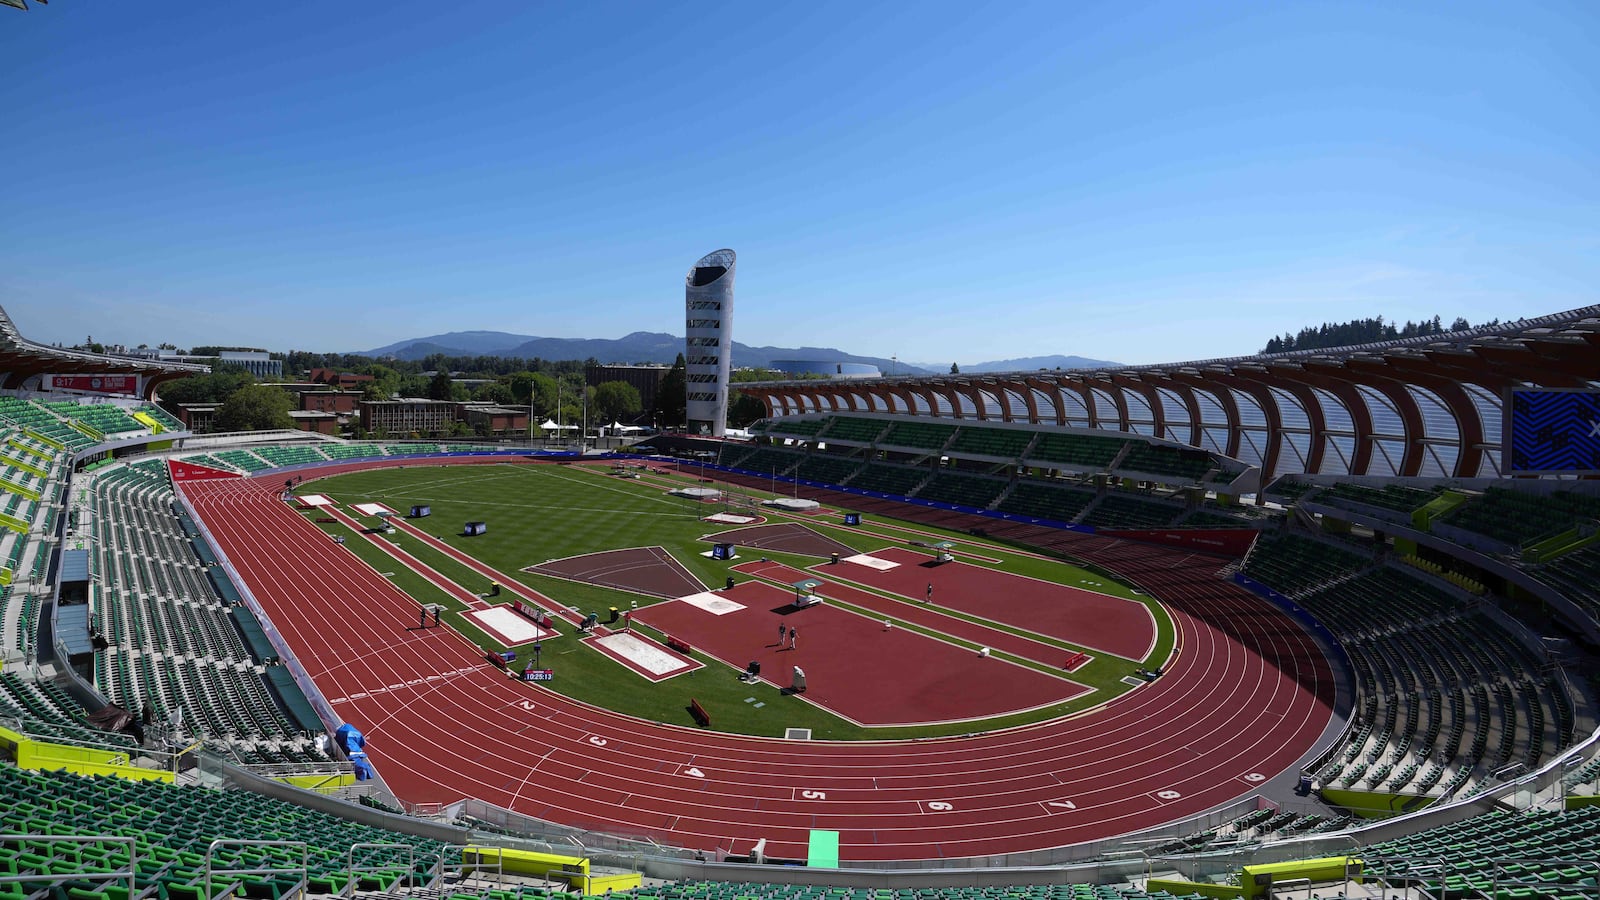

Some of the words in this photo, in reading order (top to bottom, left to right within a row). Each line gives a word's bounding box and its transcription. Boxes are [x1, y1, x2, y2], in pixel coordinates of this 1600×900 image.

[56, 378, 74, 386] 9:17
[520, 700, 536, 710] 2
[589, 736, 607, 746] 3
[684, 767, 705, 778] 4
[1244, 773, 1266, 782] 9
[801, 790, 826, 800] 5
[1157, 790, 1181, 799] 8
[927, 801, 953, 811] 6
[1047, 800, 1077, 810] 7
